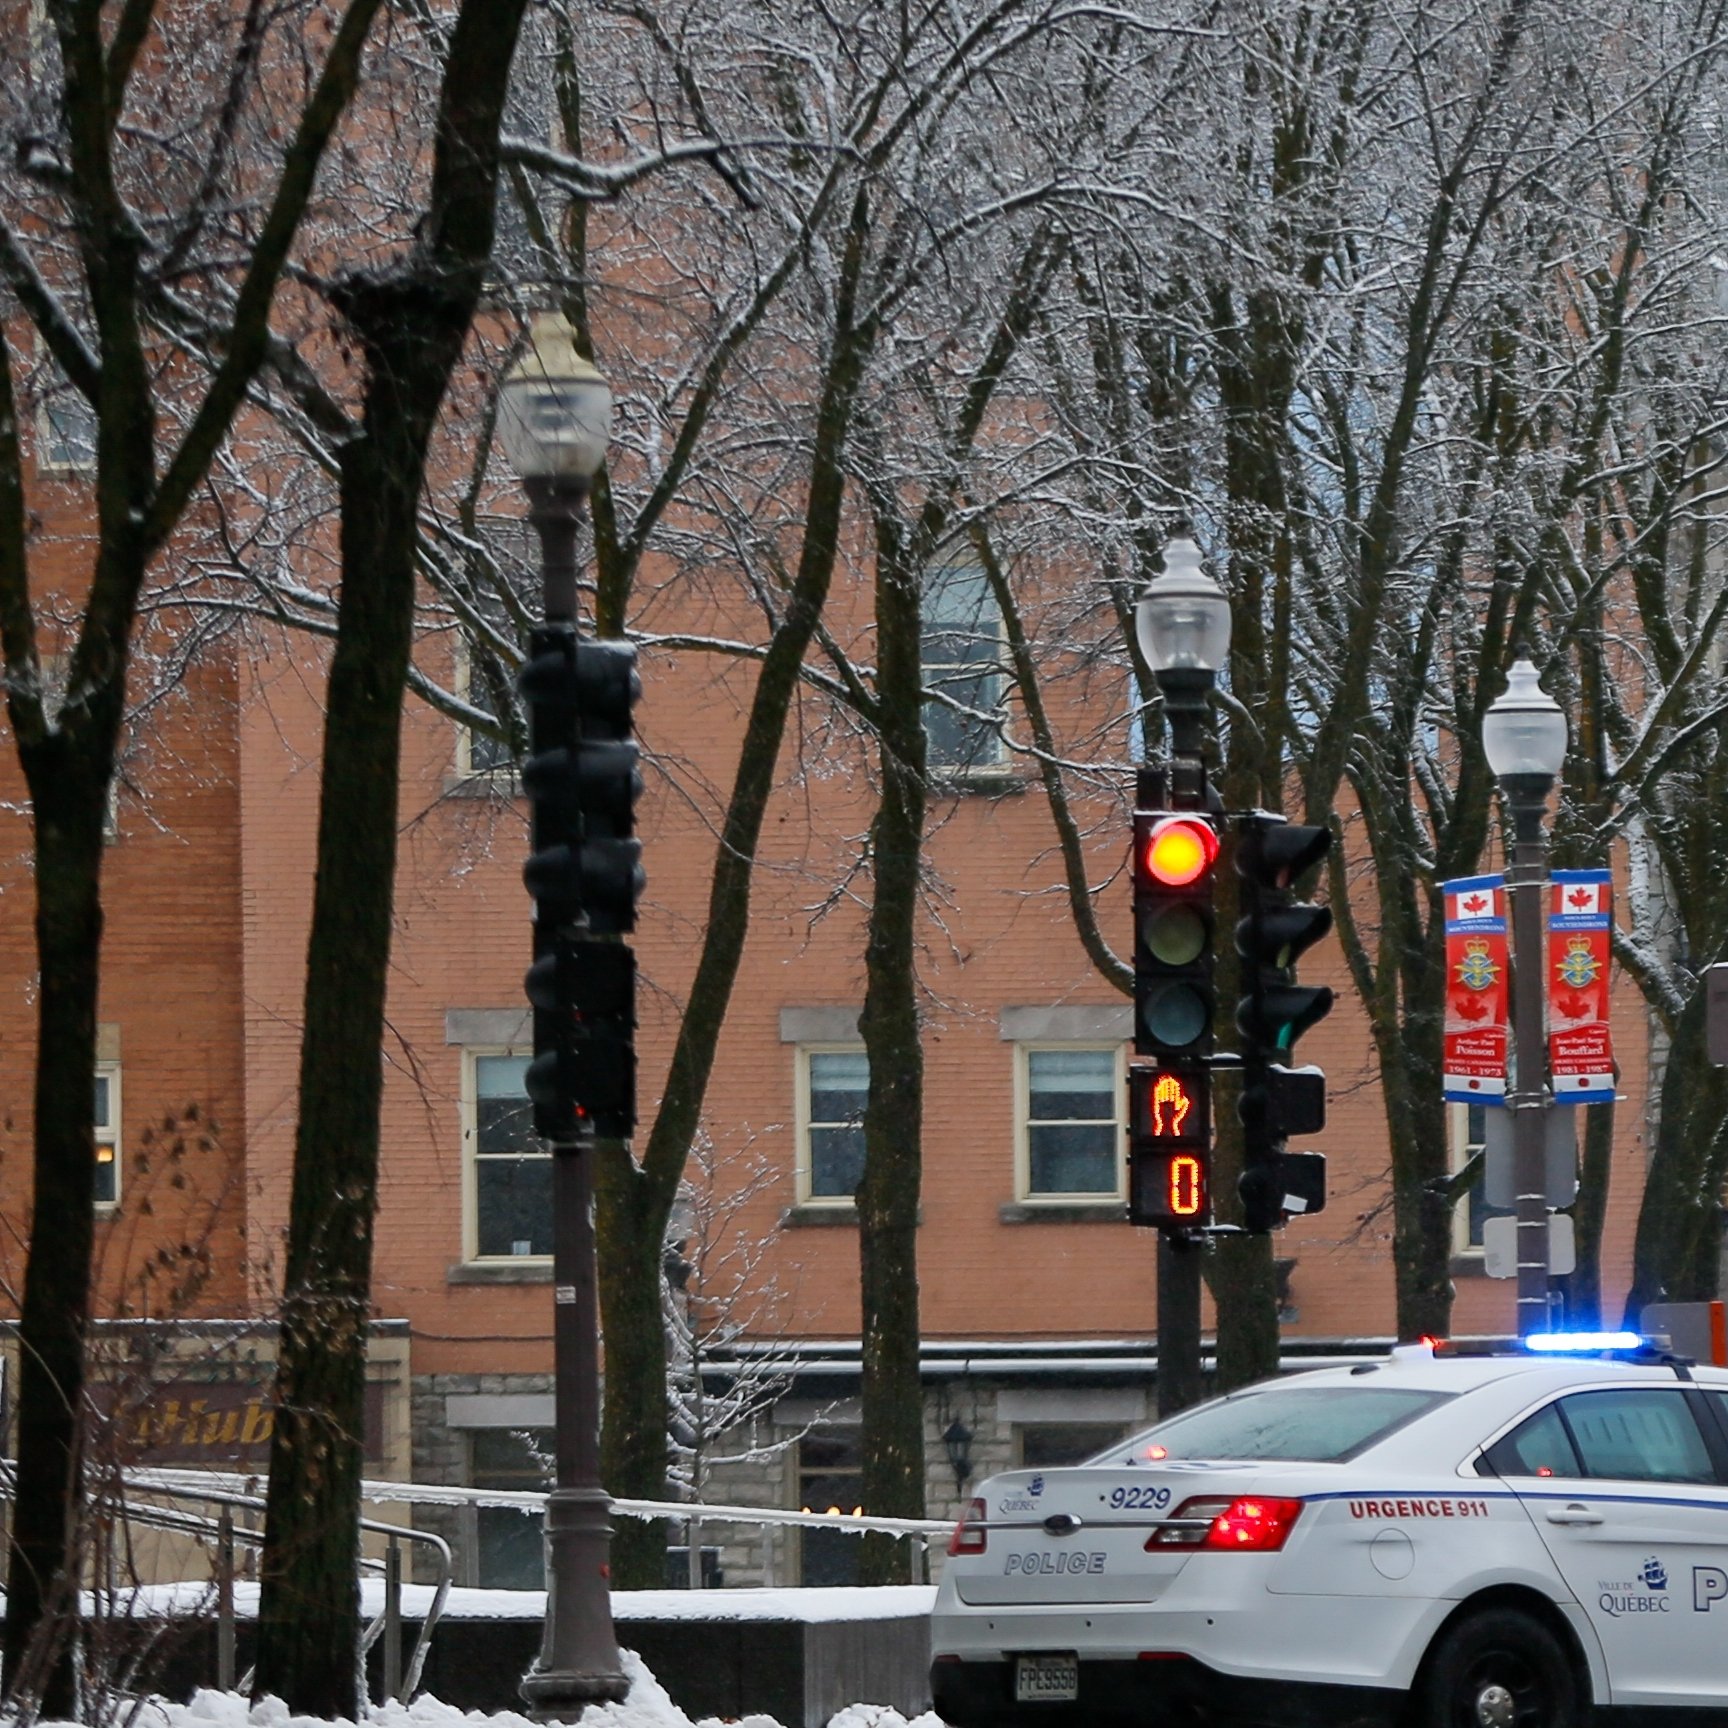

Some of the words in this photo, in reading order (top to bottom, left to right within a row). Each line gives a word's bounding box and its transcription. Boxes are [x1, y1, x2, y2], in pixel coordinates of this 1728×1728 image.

[1171, 1157, 1199, 1215] 0
[1109, 1486, 1172, 1510] 9229
[1349, 1500, 1455, 1519] URGENCE
[1457, 1500, 1489, 1517] 911
[1004, 1552, 1107, 1576] POLICE
[1599, 1592, 1671, 1618] QUÉBEC
